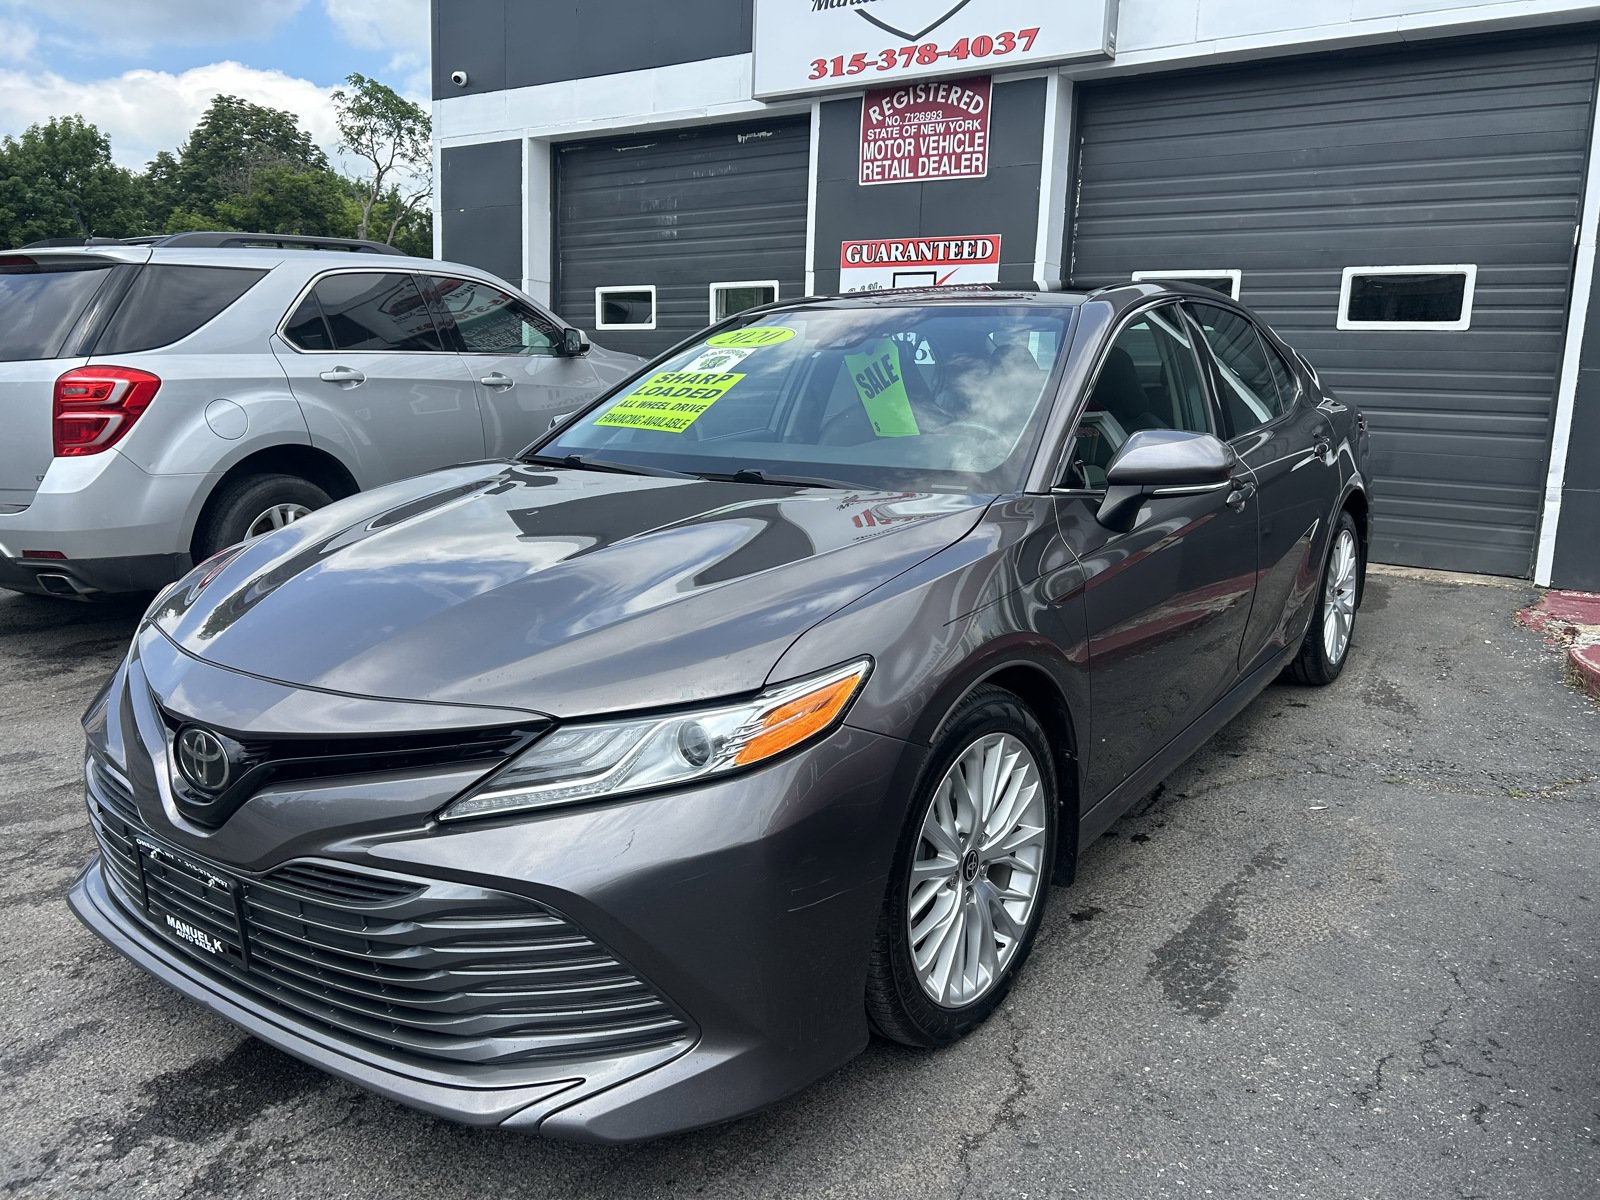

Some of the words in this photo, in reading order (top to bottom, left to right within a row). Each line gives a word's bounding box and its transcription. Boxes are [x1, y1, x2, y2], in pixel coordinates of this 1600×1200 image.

[808, 27, 1041, 80] 315-378-4037
[868, 83, 984, 125] REGISTERED
[867, 127, 900, 140] STATE
[902, 125, 918, 136] OF
[920, 122, 946, 135] NEW
[949, 119, 981, 132] YORK
[885, 115, 903, 126] NO.
[904, 110, 943, 123] 7126993
[863, 138, 915, 160] MOTOR
[919, 132, 985, 155] VEHICLE
[863, 158, 914, 180] RETAIL
[918, 153, 984, 176] DEALER
[845, 239, 994, 264] GUARANTEED
[654, 373, 734, 385] SHARP
[855, 353, 900, 400] SALE
[631, 386, 723, 400] LOADED
[617, 400, 638, 408] ALL
[637, 400, 670, 411] WHEEL
[670, 404, 708, 413] DRIVE
[598, 413, 645, 425] FINANCING
[641, 417, 691, 429] AVAILABLE
[166, 914, 212, 946] MANUEL
[213, 938, 223, 953] K
[176, 929, 194, 942] AUTO
